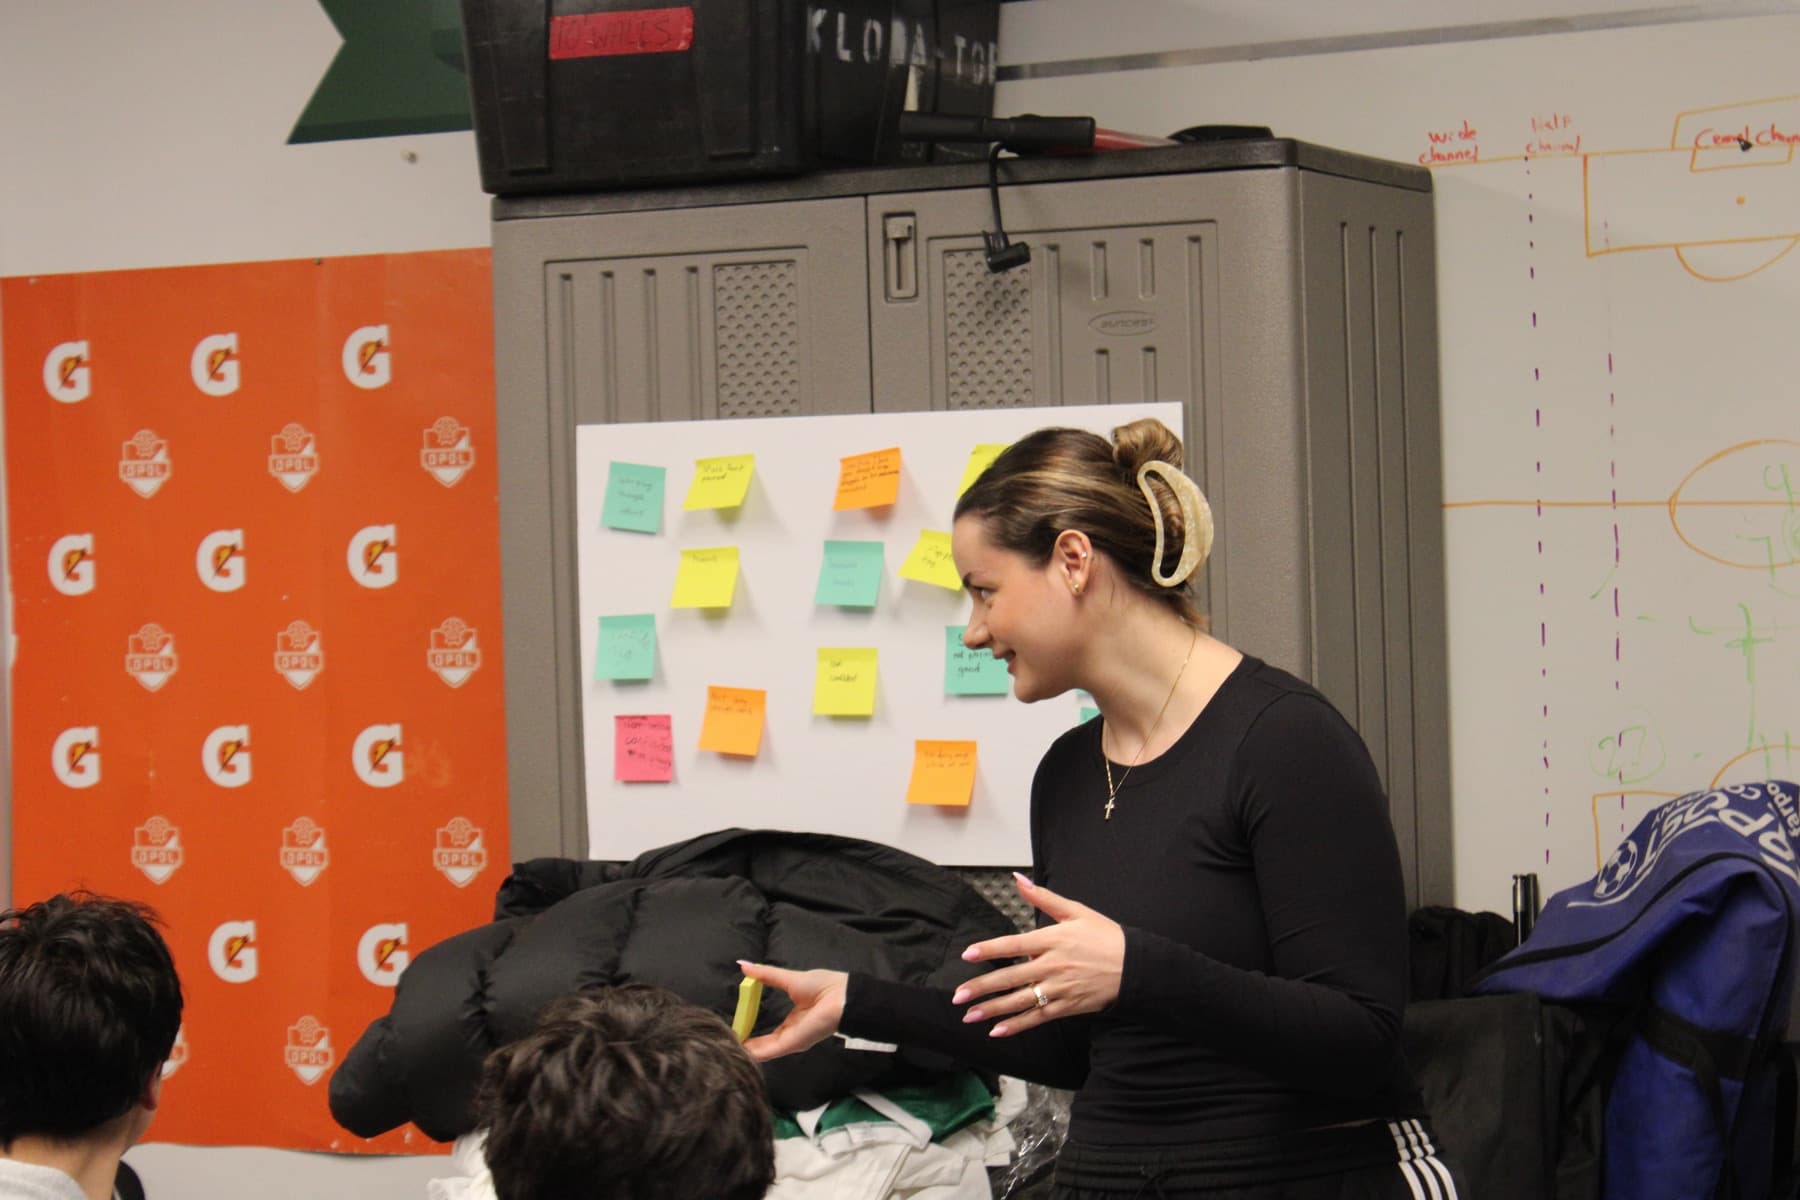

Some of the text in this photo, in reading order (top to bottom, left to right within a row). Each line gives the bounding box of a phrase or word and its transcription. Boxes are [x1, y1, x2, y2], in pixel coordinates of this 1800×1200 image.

[44, 325, 391, 403] G G G
[49, 525, 398, 596] G G G
[53, 724, 404, 788] G G G
[209, 921, 409, 987] G G
